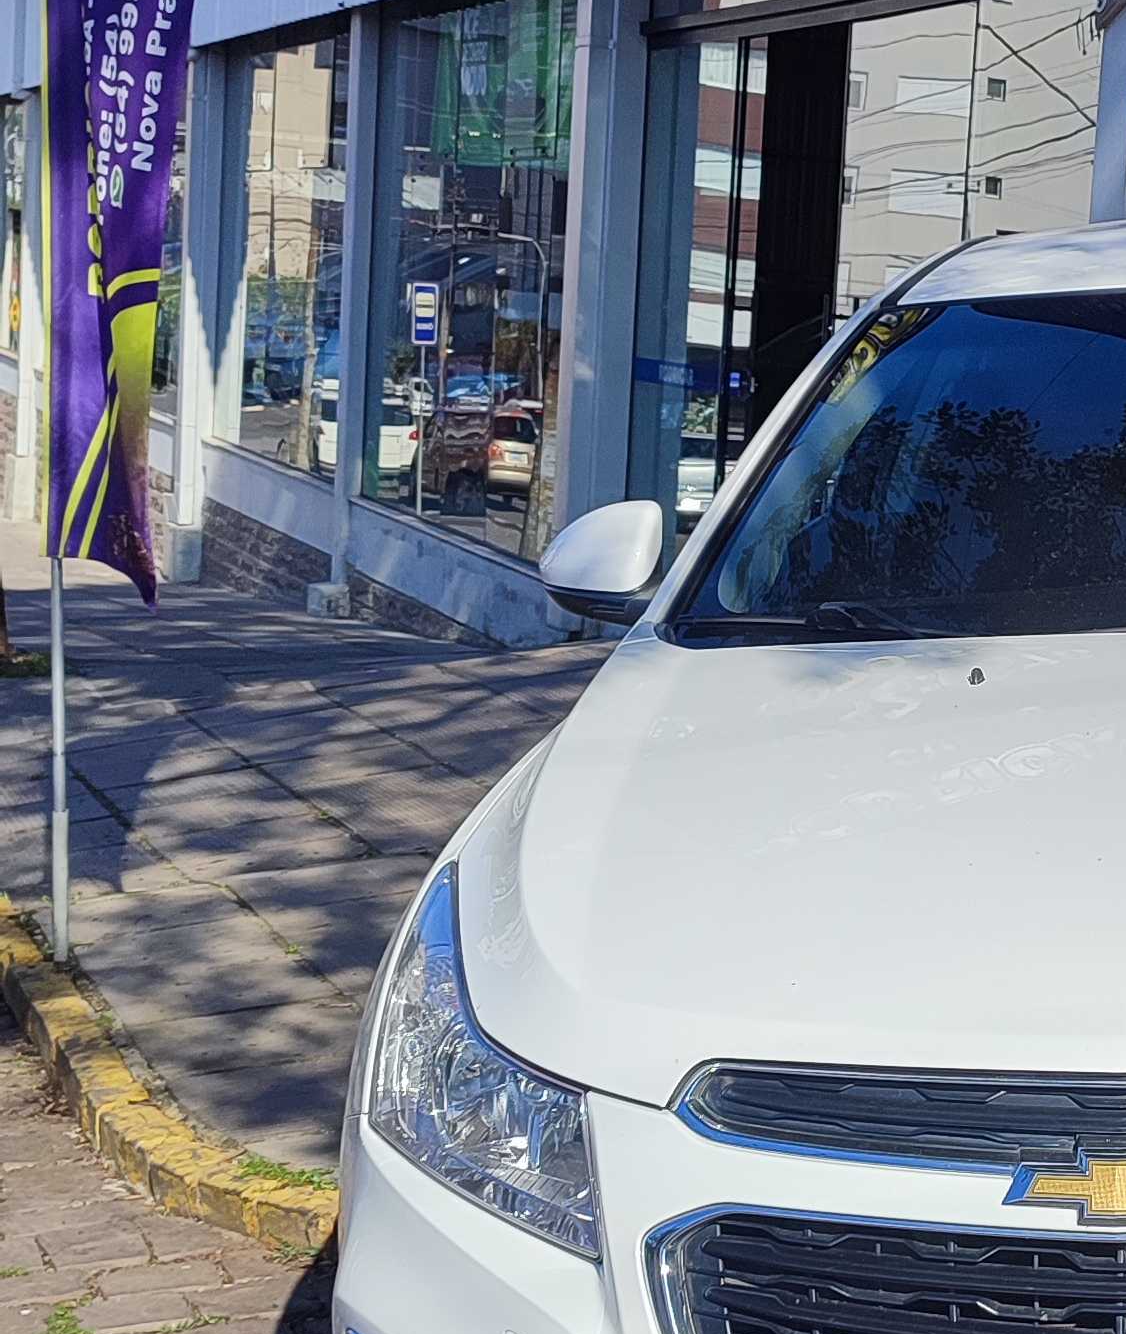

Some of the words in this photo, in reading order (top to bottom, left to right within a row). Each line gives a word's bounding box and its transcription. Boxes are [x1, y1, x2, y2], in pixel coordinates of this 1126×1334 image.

[99, 14, 119, 98] (54)
[95, 110, 115, 225] one:
[131, 71, 162, 172] Nova
